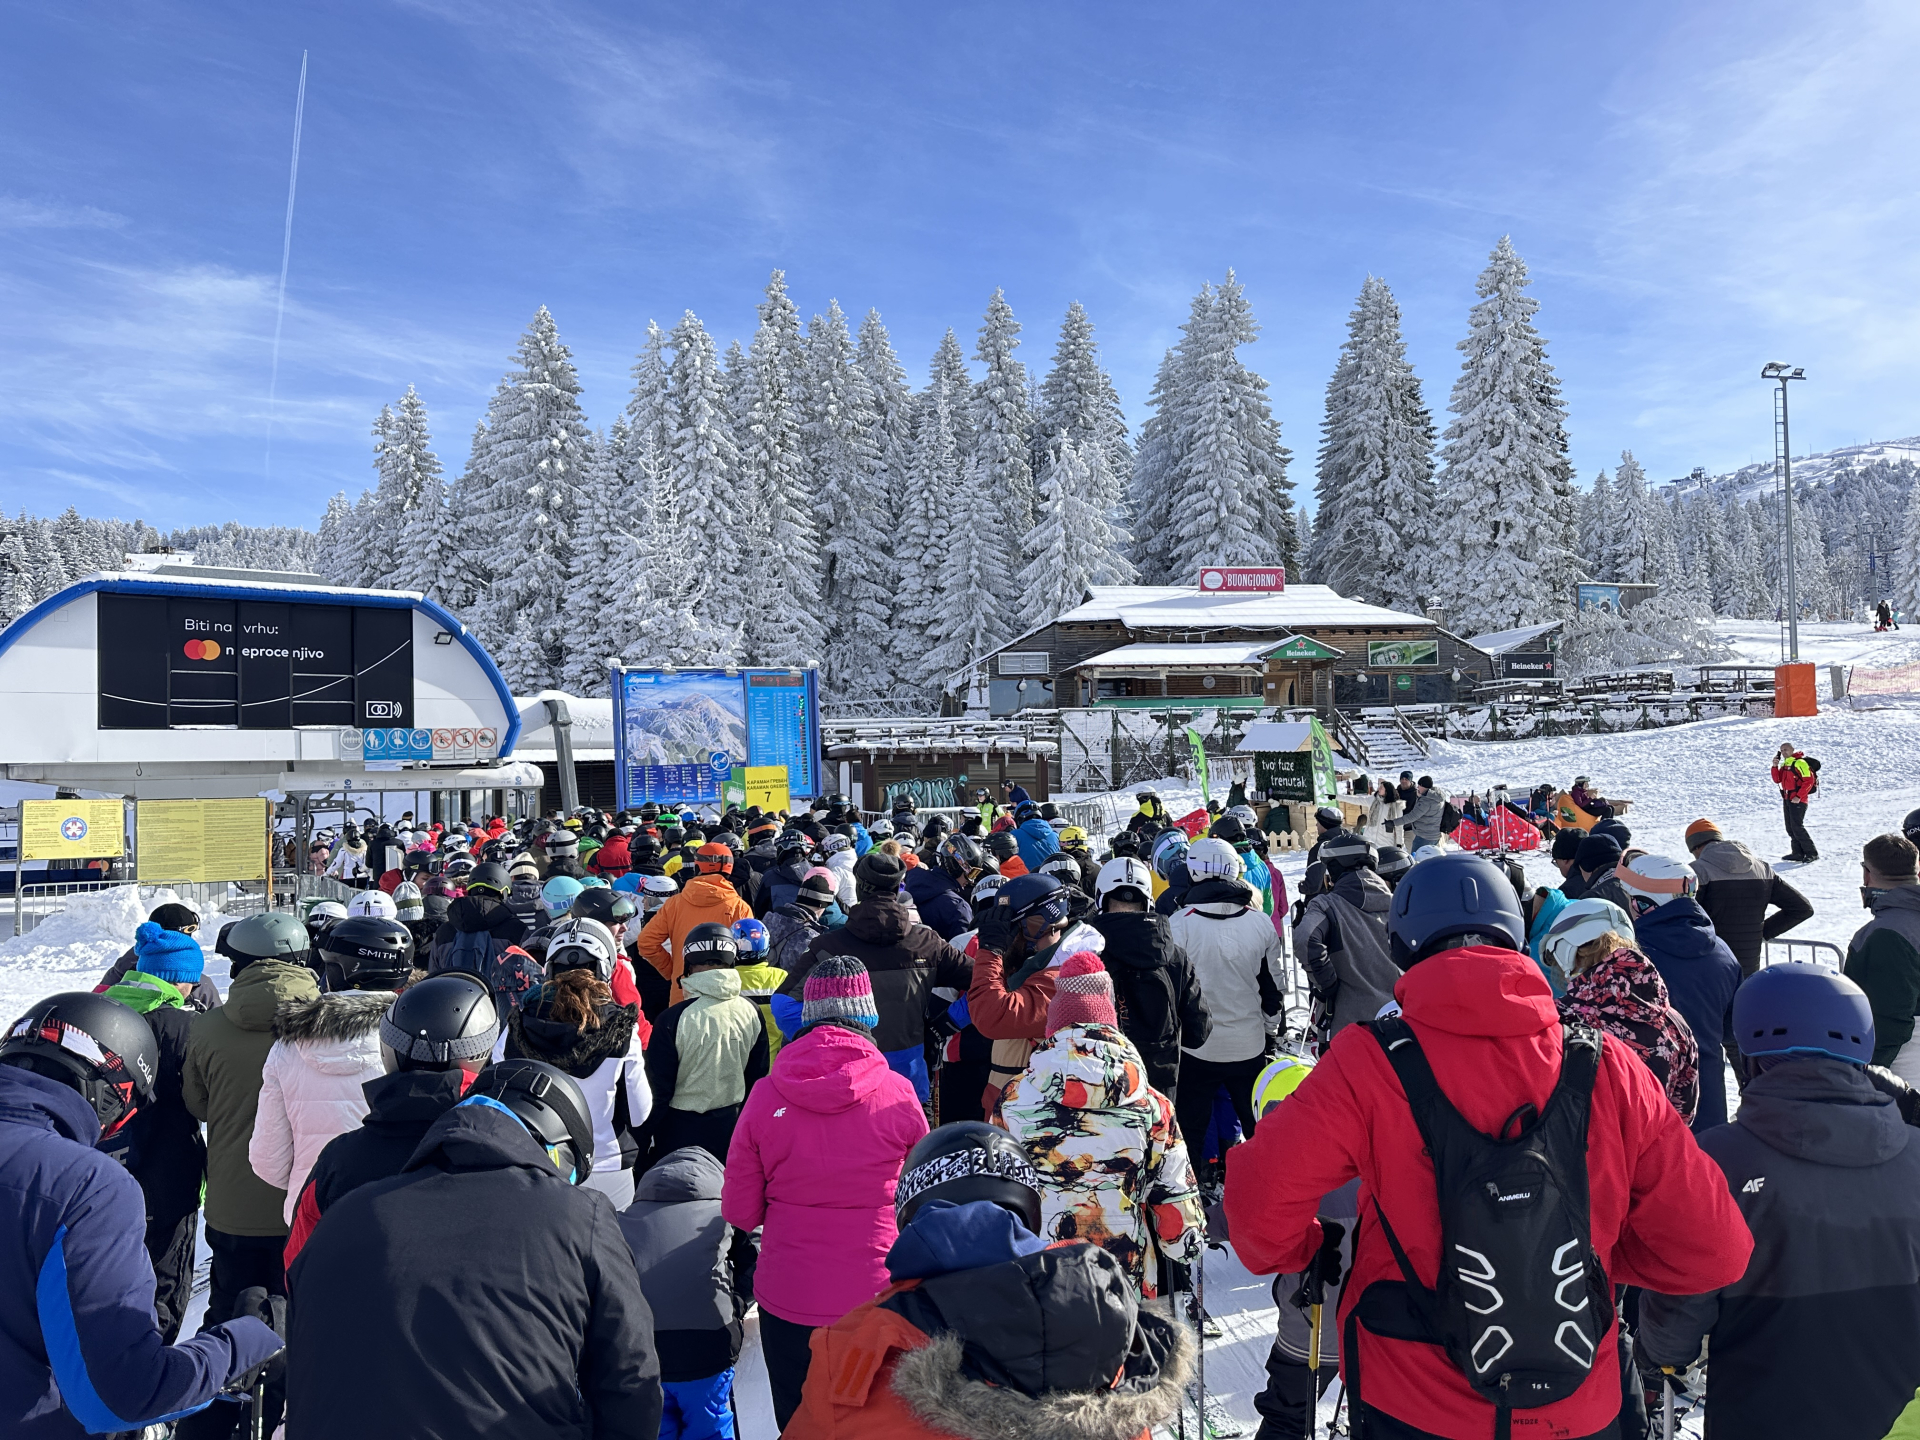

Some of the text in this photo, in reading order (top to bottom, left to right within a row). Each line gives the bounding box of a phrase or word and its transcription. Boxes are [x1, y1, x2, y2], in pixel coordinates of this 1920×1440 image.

[1227, 573, 1276, 587] BUONGIORNO
[184, 618, 279, 635] Biti na vrhu:
[1286, 649, 1317, 657] Heineken
[1511, 662, 1544, 670] Heineken
[1270, 775, 1307, 788] trenutak
[764, 791, 772, 803] 7
[357, 948, 397, 960] SMITH
[1498, 1192, 1531, 1202] ANMEILU
